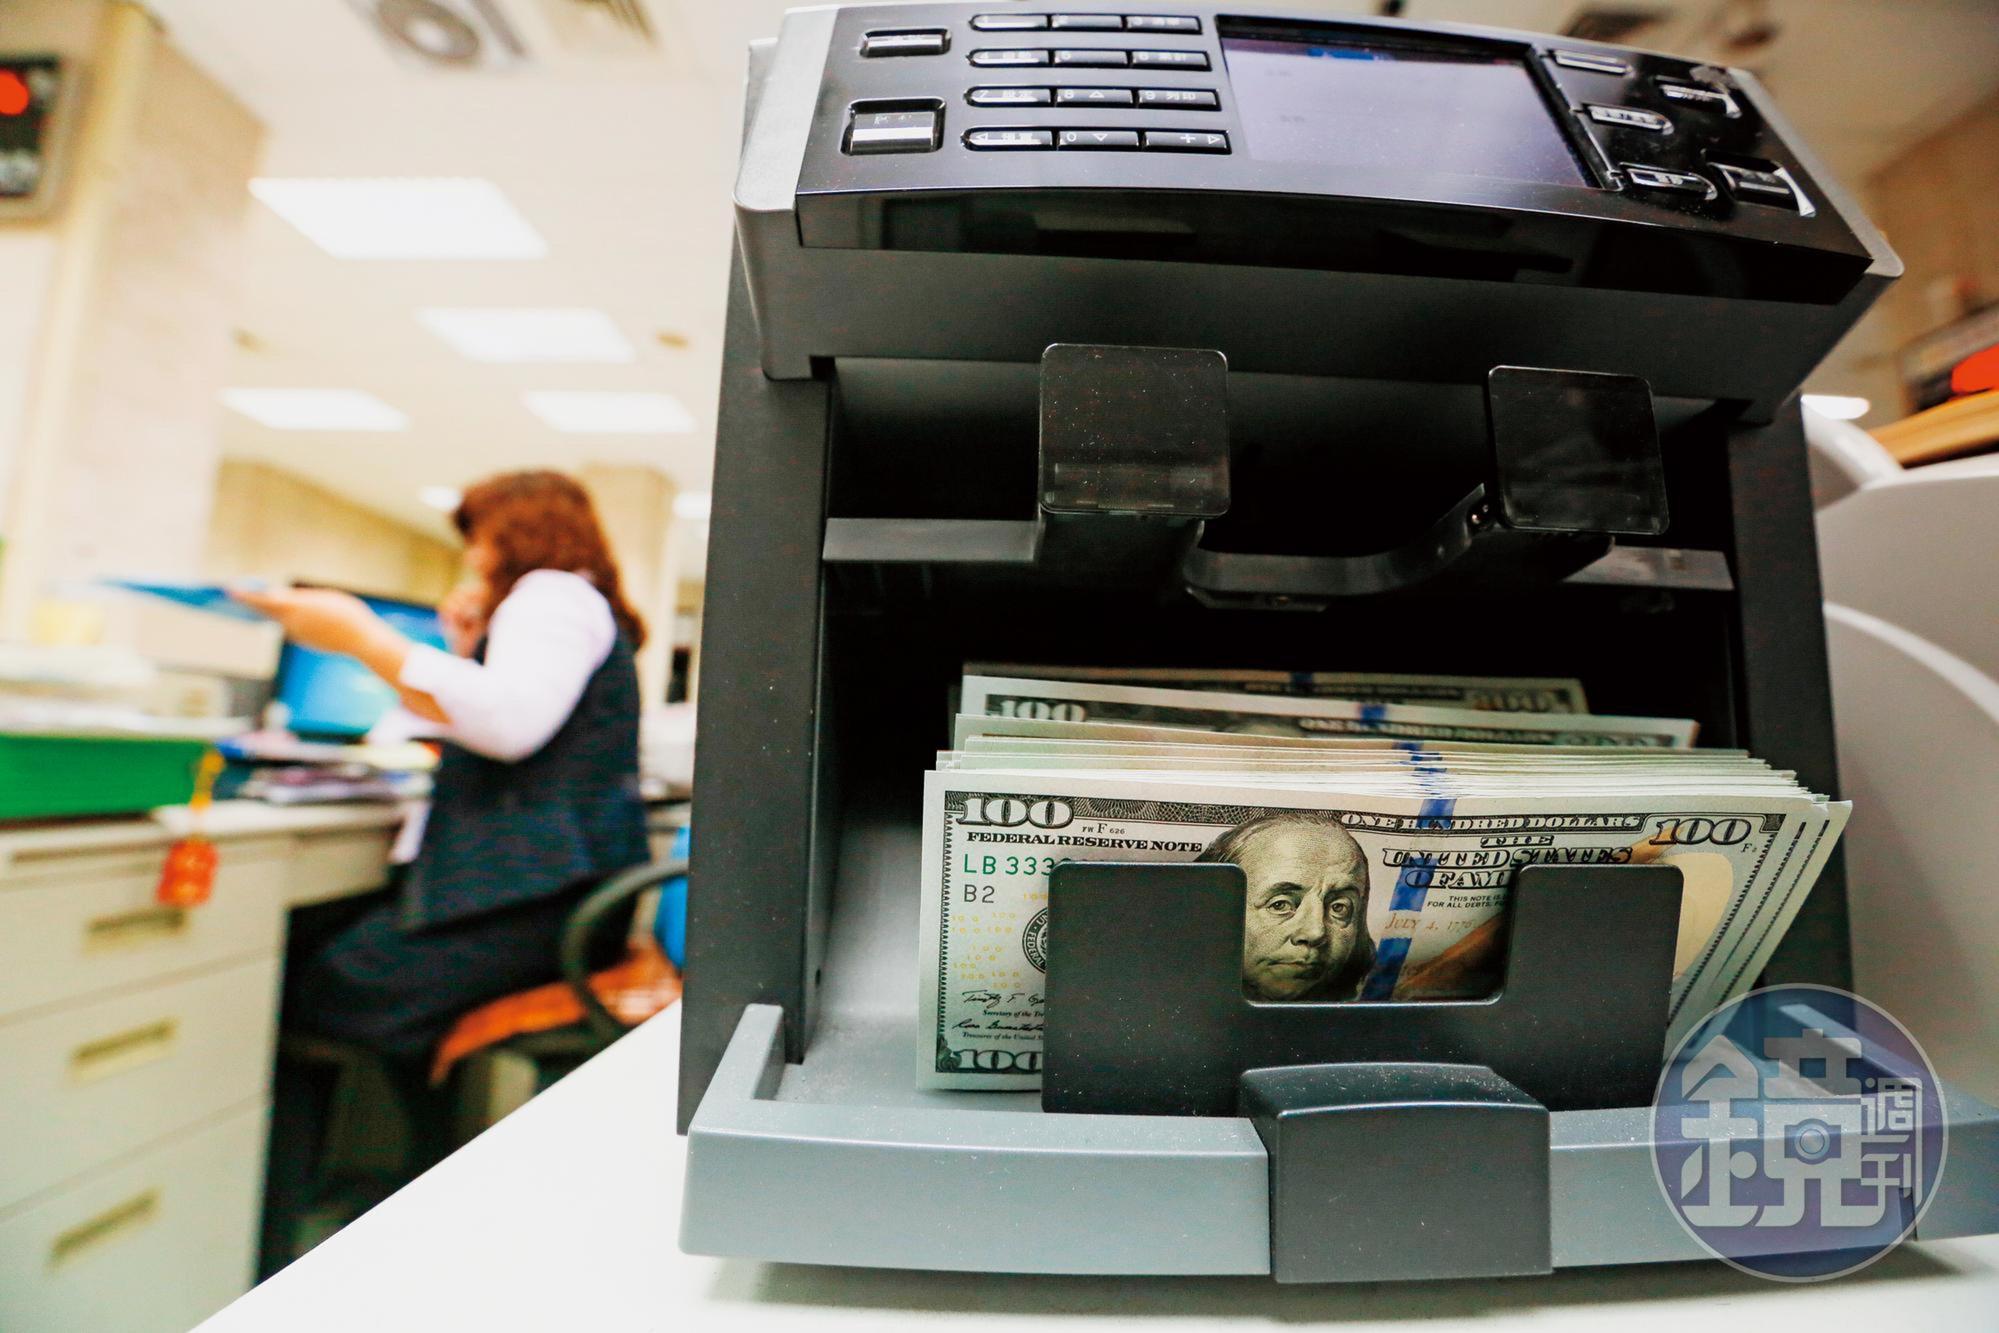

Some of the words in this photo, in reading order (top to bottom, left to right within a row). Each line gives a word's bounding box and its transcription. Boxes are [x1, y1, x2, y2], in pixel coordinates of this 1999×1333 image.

[1063, 90, 1074, 99] 8
[1144, 91, 1156, 100] 9
[956, 797, 1075, 829] 100
[1341, 813, 1397, 827] ONE
[1399, 816, 1525, 830] HUNDRED
[1526, 815, 1642, 829] DOLLARS
[967, 831, 1056, 845] FEDERAL
[1057, 834, 1148, 850] RESERVE
[1149, 840, 1203, 853] NOTE
[1480, 834, 1555, 848] THE
[1649, 817, 1752, 846] 100
[1382, 847, 1511, 869] UNITED
[1510, 846, 1634, 866] STATES
[1404, 869, 1454, 889] OF
[1449, 869, 1512, 890] AM
[963, 883, 996, 904] B2
[1446, 901, 1462, 909] ALL
